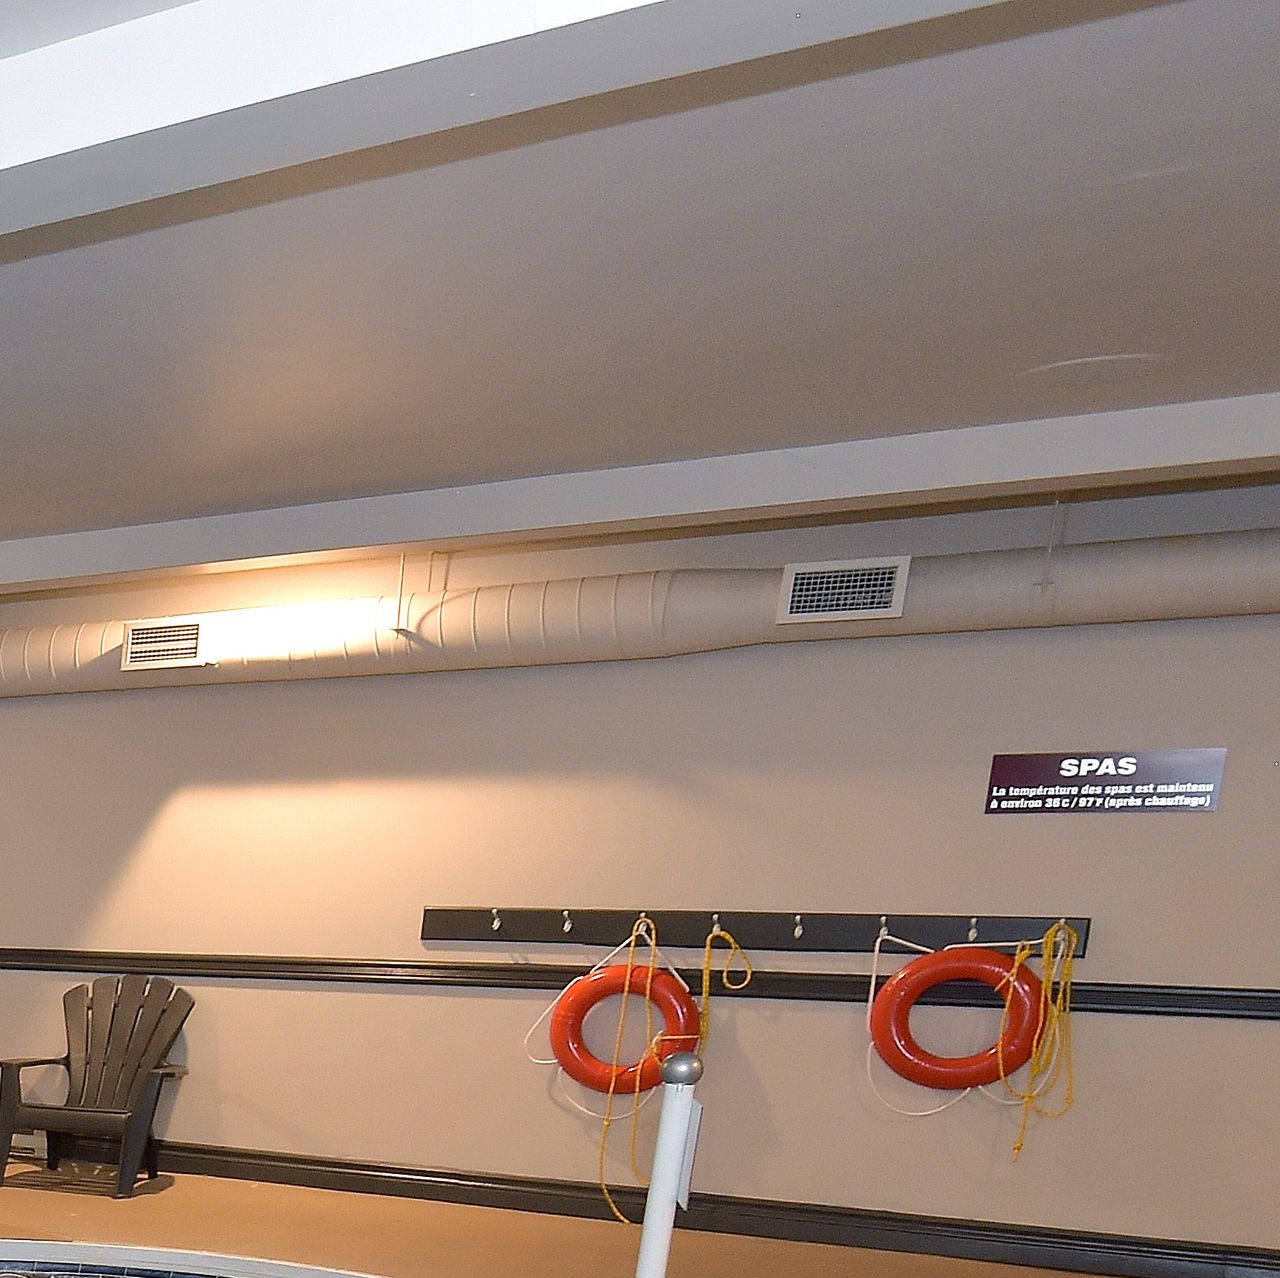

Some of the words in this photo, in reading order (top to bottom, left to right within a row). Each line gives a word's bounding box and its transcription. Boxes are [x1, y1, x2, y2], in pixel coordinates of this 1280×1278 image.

[1059, 756, 1137, 777] SPAS
[992, 786, 1006, 796] La
[1008, 785, 1079, 797] température
[1080, 784, 1102, 795] des
[1104, 784, 1133, 796] spas
[1134, 783, 1154, 793] est
[1000, 798, 1042, 808] environ
[1144, 794, 1211, 808] chauffage)
